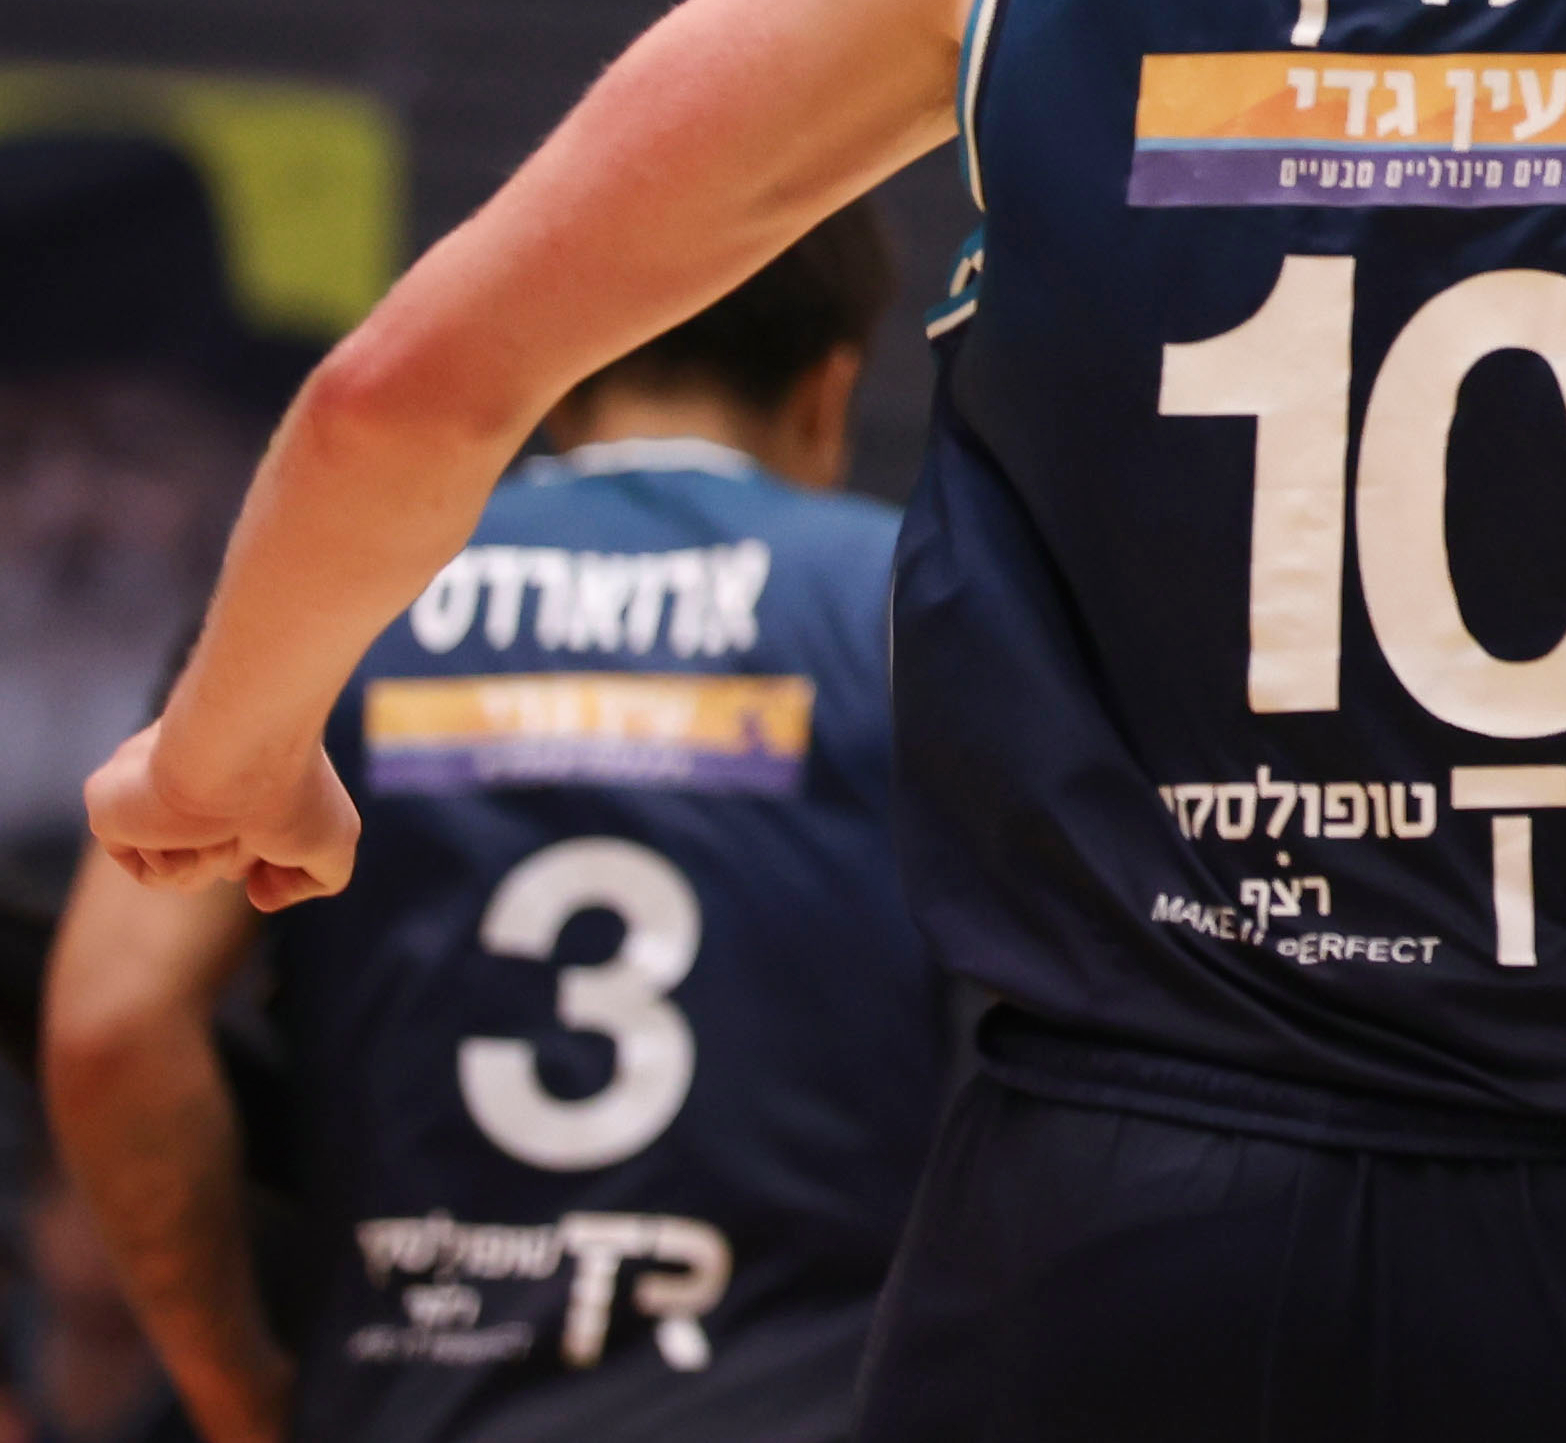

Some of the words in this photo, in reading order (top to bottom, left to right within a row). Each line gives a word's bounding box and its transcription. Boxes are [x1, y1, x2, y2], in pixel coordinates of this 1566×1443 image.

[1286, 68, 1418, 138] גדי
[1384, 156, 1503, 189] מינרליים
[1513, 159, 1562, 188] מים
[1158, 764, 1438, 840] טופולסקי
[1152, 892, 1238, 940] MAKE
[1240, 876, 1331, 932] רצף
[458, 835, 704, 1172] 3
[558, 1212, 735, 1371] TR
